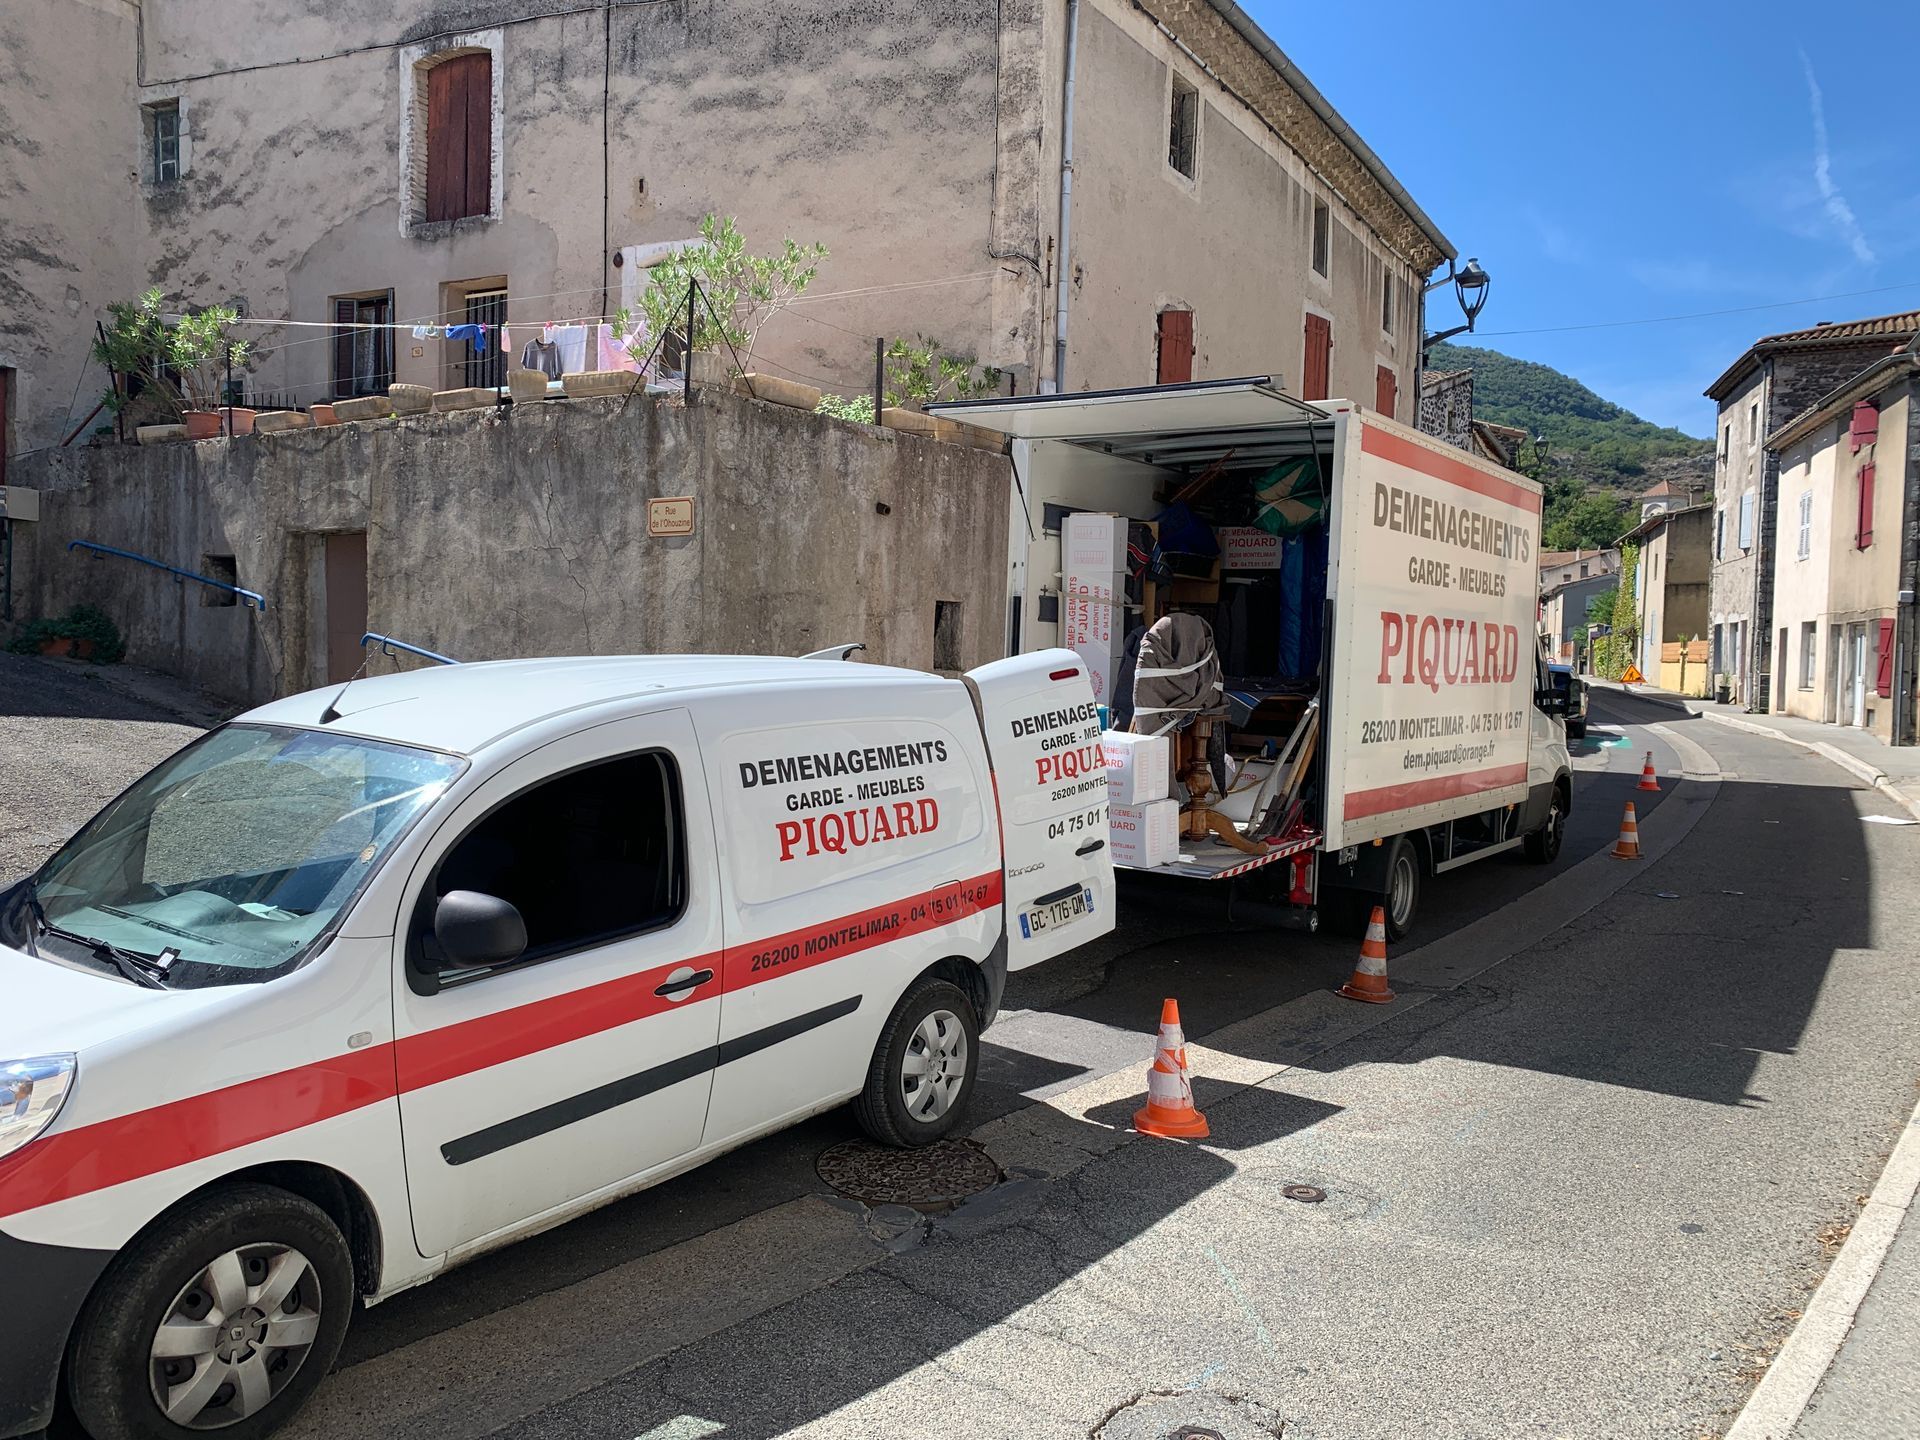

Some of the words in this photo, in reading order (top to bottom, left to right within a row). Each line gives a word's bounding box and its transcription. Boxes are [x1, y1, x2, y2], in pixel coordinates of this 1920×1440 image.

[652, 519, 659, 528] de
[665, 506, 676, 515] Rue
[1374, 482, 1530, 563] DEMENAGEMENTS
[1229, 537, 1277, 547] PIQUARD
[1409, 556, 1450, 588] GARDE
[1459, 566, 1506, 597] MEUBLES
[1377, 611, 1519, 693] PIQUARD
[1011, 702, 1099, 738] DEMENAGE
[1362, 719, 1396, 744] 26200
[1399, 715, 1464, 740] MONTELIMAR
[1471, 714, 1480, 733] 04
[1483, 713, 1492, 732] 75
[1494, 712, 1502, 731] 01
[1505, 712, 1513, 730] 12
[1514, 711, 1523, 729] 67
[1041, 732, 1076, 751] GARDE
[1403, 740, 1495, 771] dem.piquard@orange.fr
[740, 740, 947, 788] DEMENAGEMENTS
[1035, 743, 1106, 785] PIQUA
[786, 787, 844, 812] GARDE
[857, 775, 925, 801] MEUBLES
[1051, 786, 1076, 801] 26200
[776, 798, 939, 861] PIQUARD
[1048, 821, 1064, 839] 04
[1069, 814, 1084, 832] 75
[1087, 808, 1100, 826] 01
[751, 944, 800, 972] 26200
[804, 912, 900, 956] MONTELIMAR
[910, 904, 926, 922] 04
[929, 900, 943, 914] 75
[946, 895, 959, 911] 01
[961, 890, 974, 905] 12
[976, 884, 989, 900] 67
